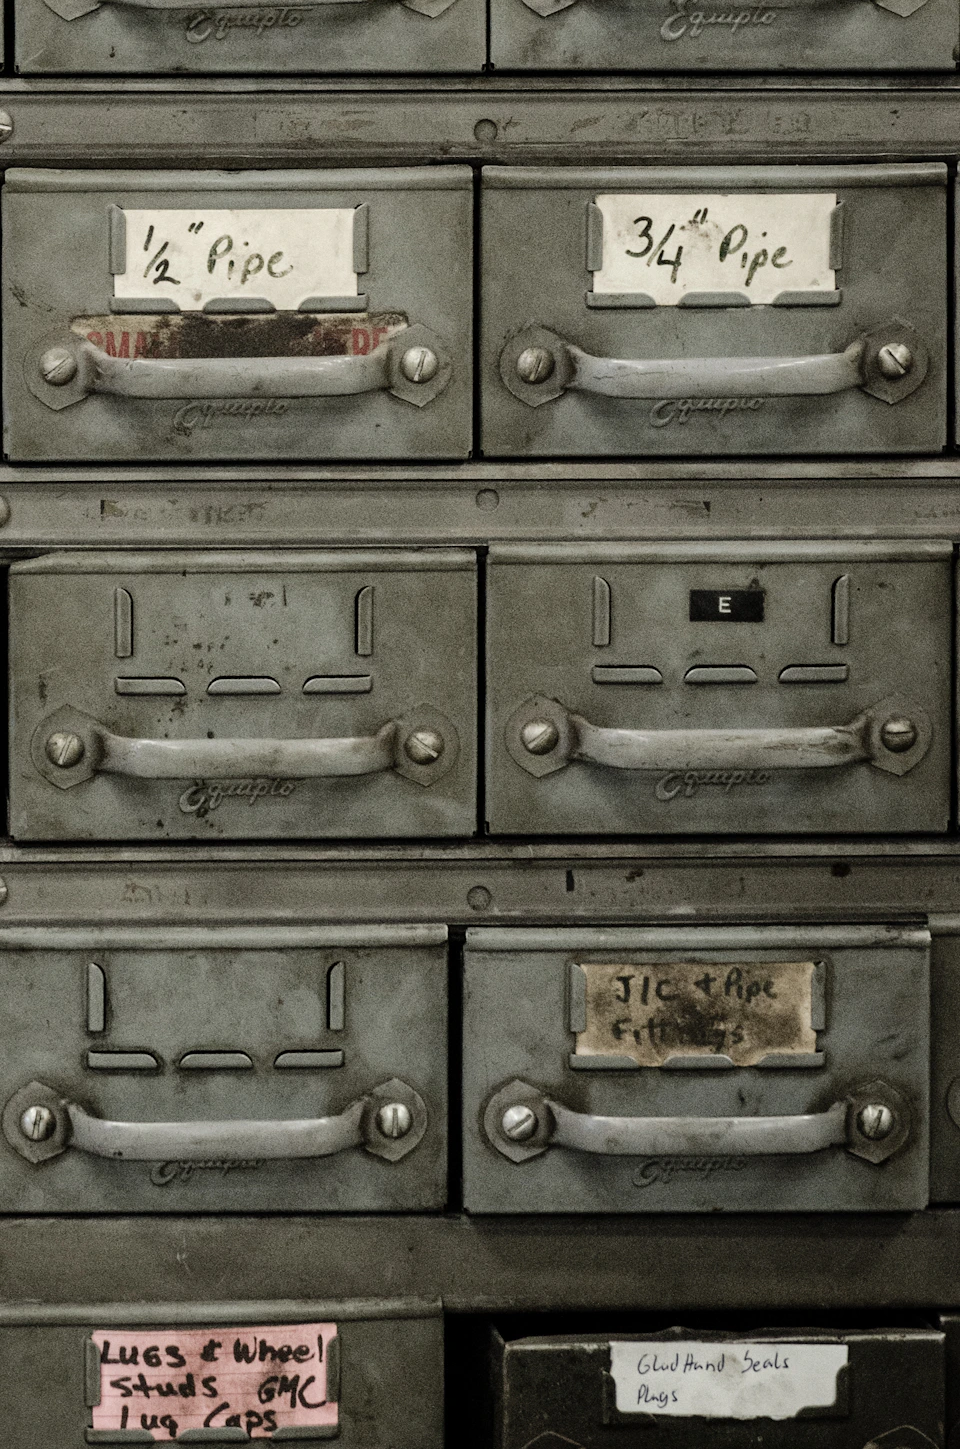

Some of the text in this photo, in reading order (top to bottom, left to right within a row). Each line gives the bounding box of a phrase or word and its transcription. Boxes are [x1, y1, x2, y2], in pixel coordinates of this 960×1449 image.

[207, 234, 294, 284] Pipe
[719, 224, 793, 287] Pipe
[718, 596, 732, 613] E
[233, 1334, 324, 1364] Wheel
[741, 1350, 790, 1374] Seals
[258, 1374, 326, 1408] GMC
